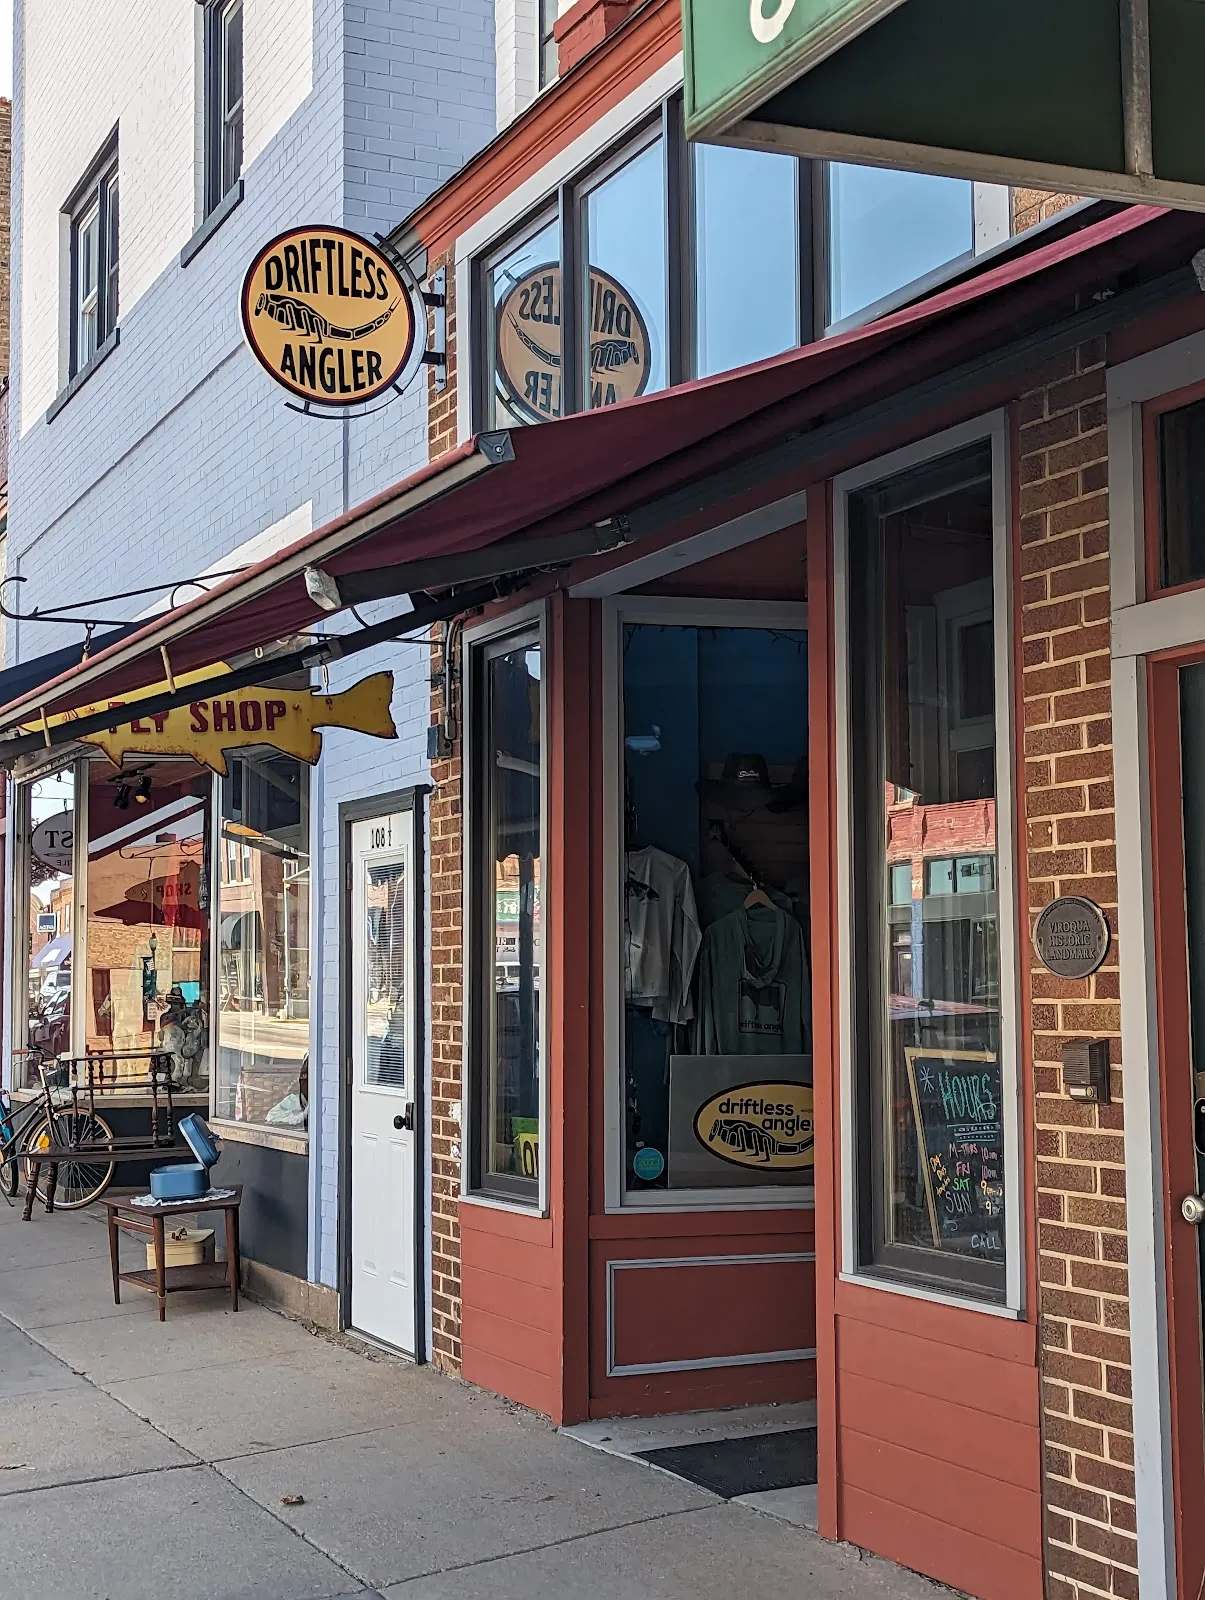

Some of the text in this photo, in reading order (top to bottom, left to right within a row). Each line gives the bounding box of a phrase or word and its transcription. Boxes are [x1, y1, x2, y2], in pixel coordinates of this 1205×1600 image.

[265, 239, 389, 300] DRIFTLESS
[280, 344, 383, 394] ANGLER
[190, 700, 287, 732] SHOP
[1049, 920, 1091, 934] VIROQUA
[1049, 934, 1091, 948] HISTORIC
[1046, 947, 1097, 960] LANDMARK
[939, 1072, 996, 1122] HOURS
[719, 1098, 794, 1116] driftless
[952, 1178, 971, 1191] SAT
[945, 1191, 973, 1214] SUN
[971, 1234, 1000, 1250] CALL
